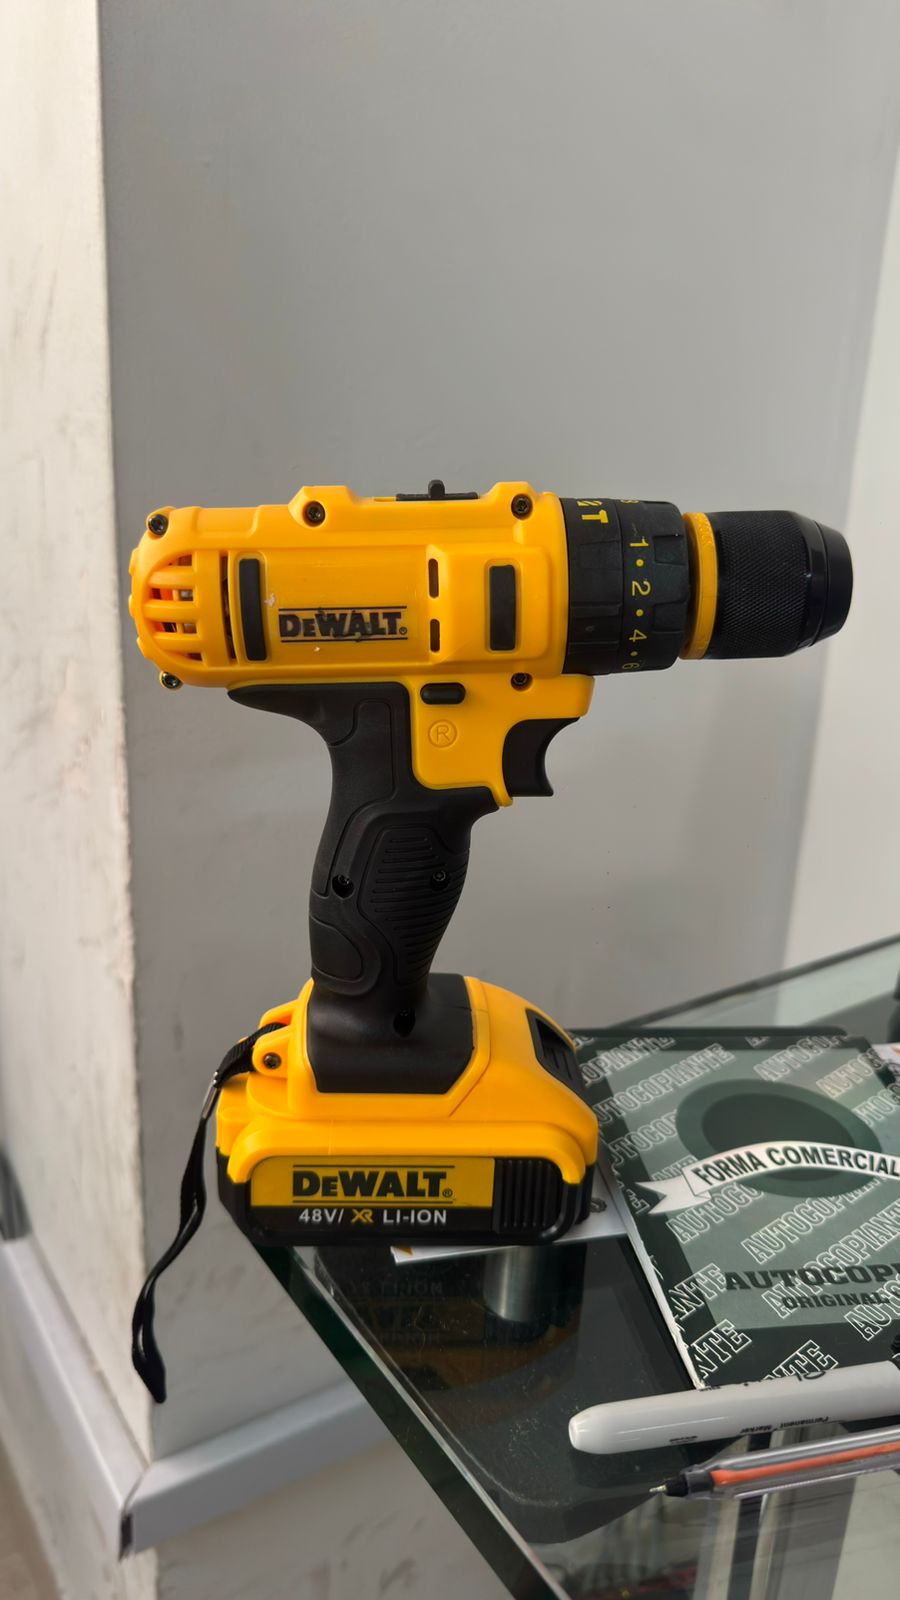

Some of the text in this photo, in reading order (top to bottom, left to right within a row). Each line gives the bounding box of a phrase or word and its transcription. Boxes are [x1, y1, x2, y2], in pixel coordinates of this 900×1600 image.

[631, 580, 651, 597] 2
[629, 628, 648, 643] 4
[691, 1151, 768, 1186] FORMA
[765, 1145, 900, 1177] COMERCIAL
[351, 1208, 375, 1224] XR
[382, 1208, 448, 1224] LI-ION
